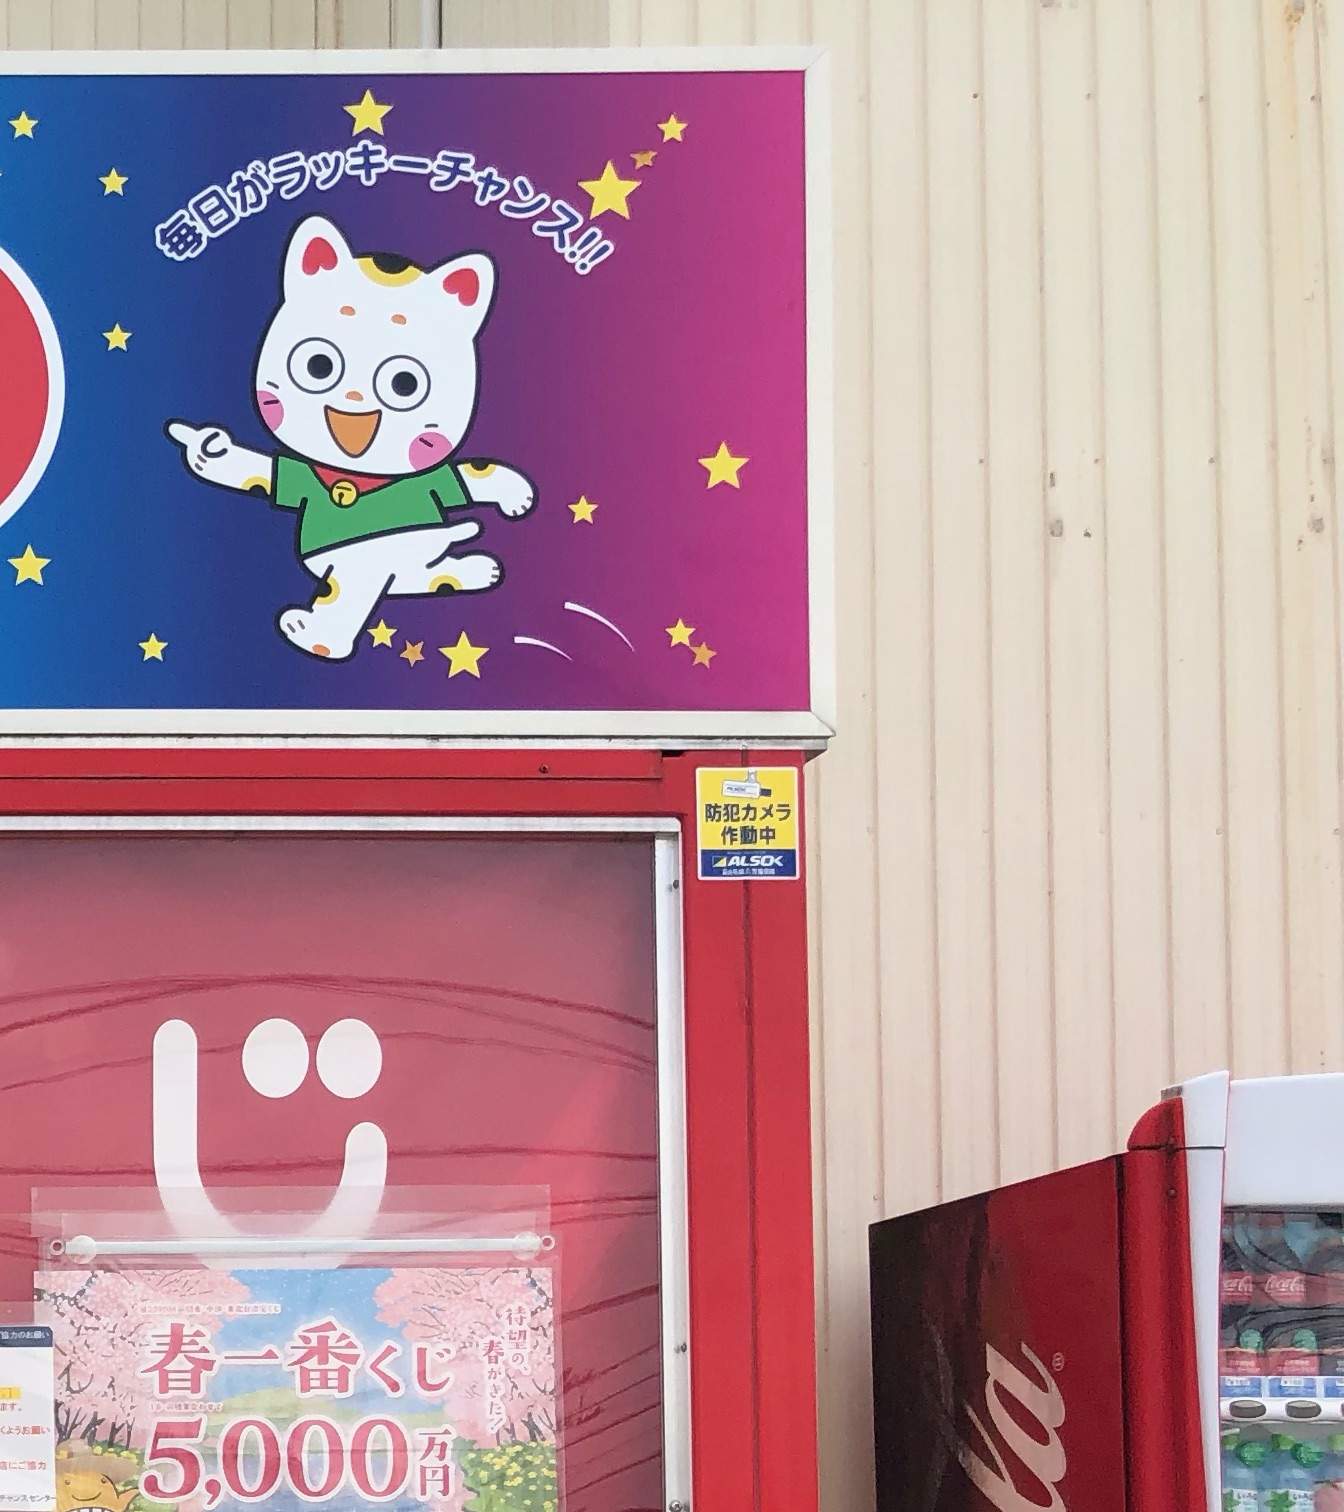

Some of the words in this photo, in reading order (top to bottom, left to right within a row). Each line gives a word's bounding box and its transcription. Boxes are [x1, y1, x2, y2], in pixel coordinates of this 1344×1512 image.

[705, 803, 791, 822] 防犯カメラ
[721, 826, 776, 845] 作動中
[727, 855, 784, 867] ALSOK
[141, 1320, 453, 1395] 春一番くじ
